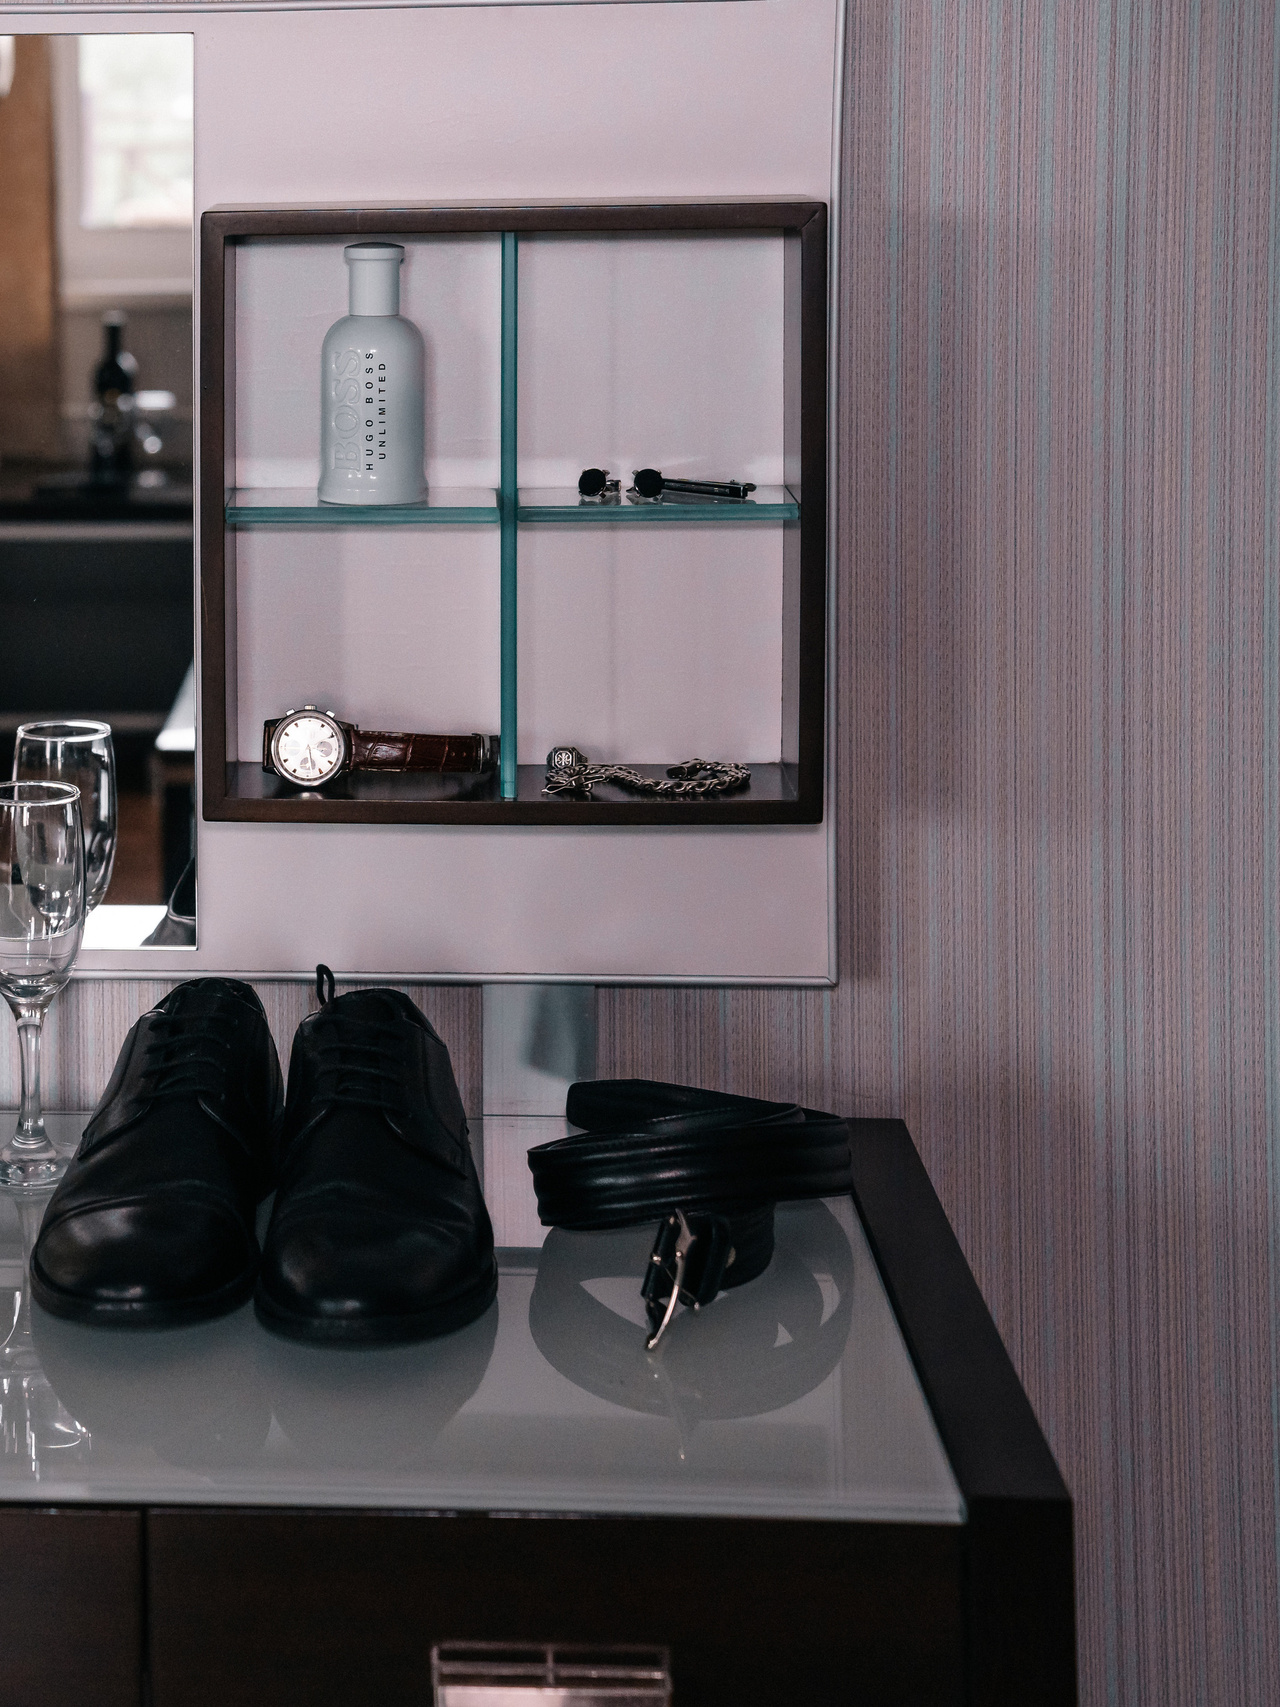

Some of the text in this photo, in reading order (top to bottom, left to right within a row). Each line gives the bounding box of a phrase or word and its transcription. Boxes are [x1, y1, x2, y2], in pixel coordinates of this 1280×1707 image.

[332, 349, 361, 473] BOSS
[364, 352, 374, 471] HUGO BOSS
[378, 363, 387, 460] UNLIMITED
